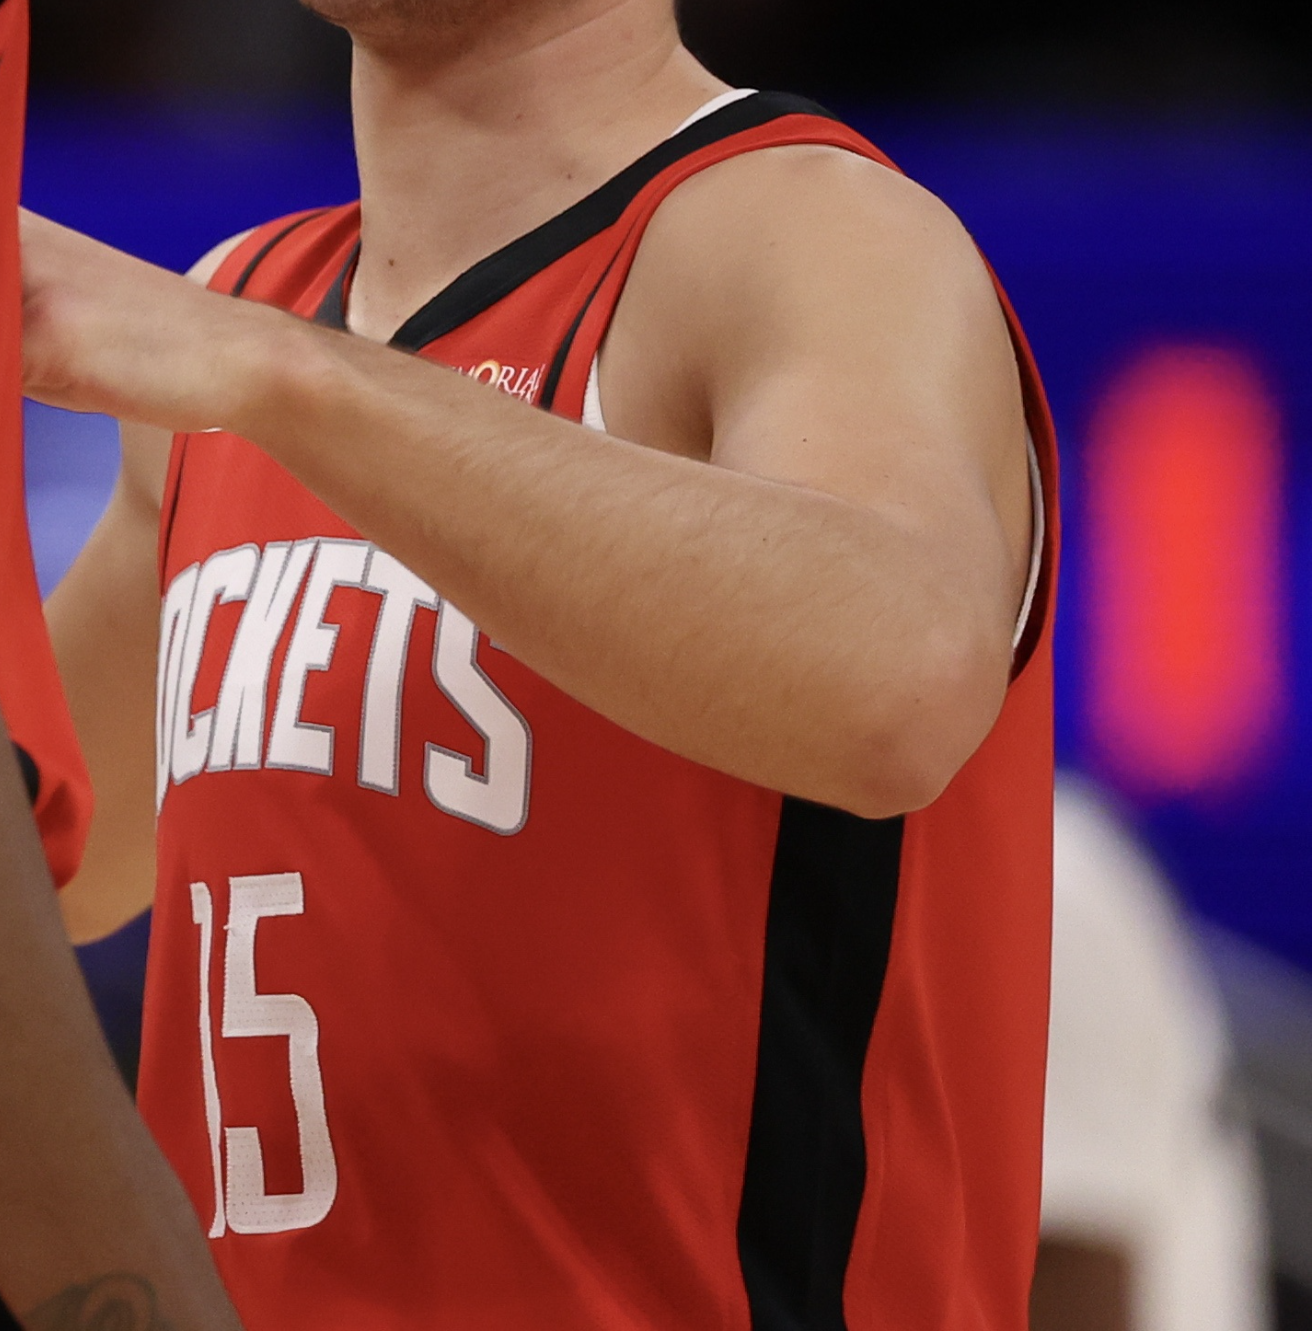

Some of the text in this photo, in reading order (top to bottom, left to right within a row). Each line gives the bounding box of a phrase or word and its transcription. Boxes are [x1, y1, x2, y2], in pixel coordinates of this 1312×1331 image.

[452, 359, 546, 396] ORIA
[155, 536, 533, 836] OCKETS
[190, 872, 338, 1239] 15
